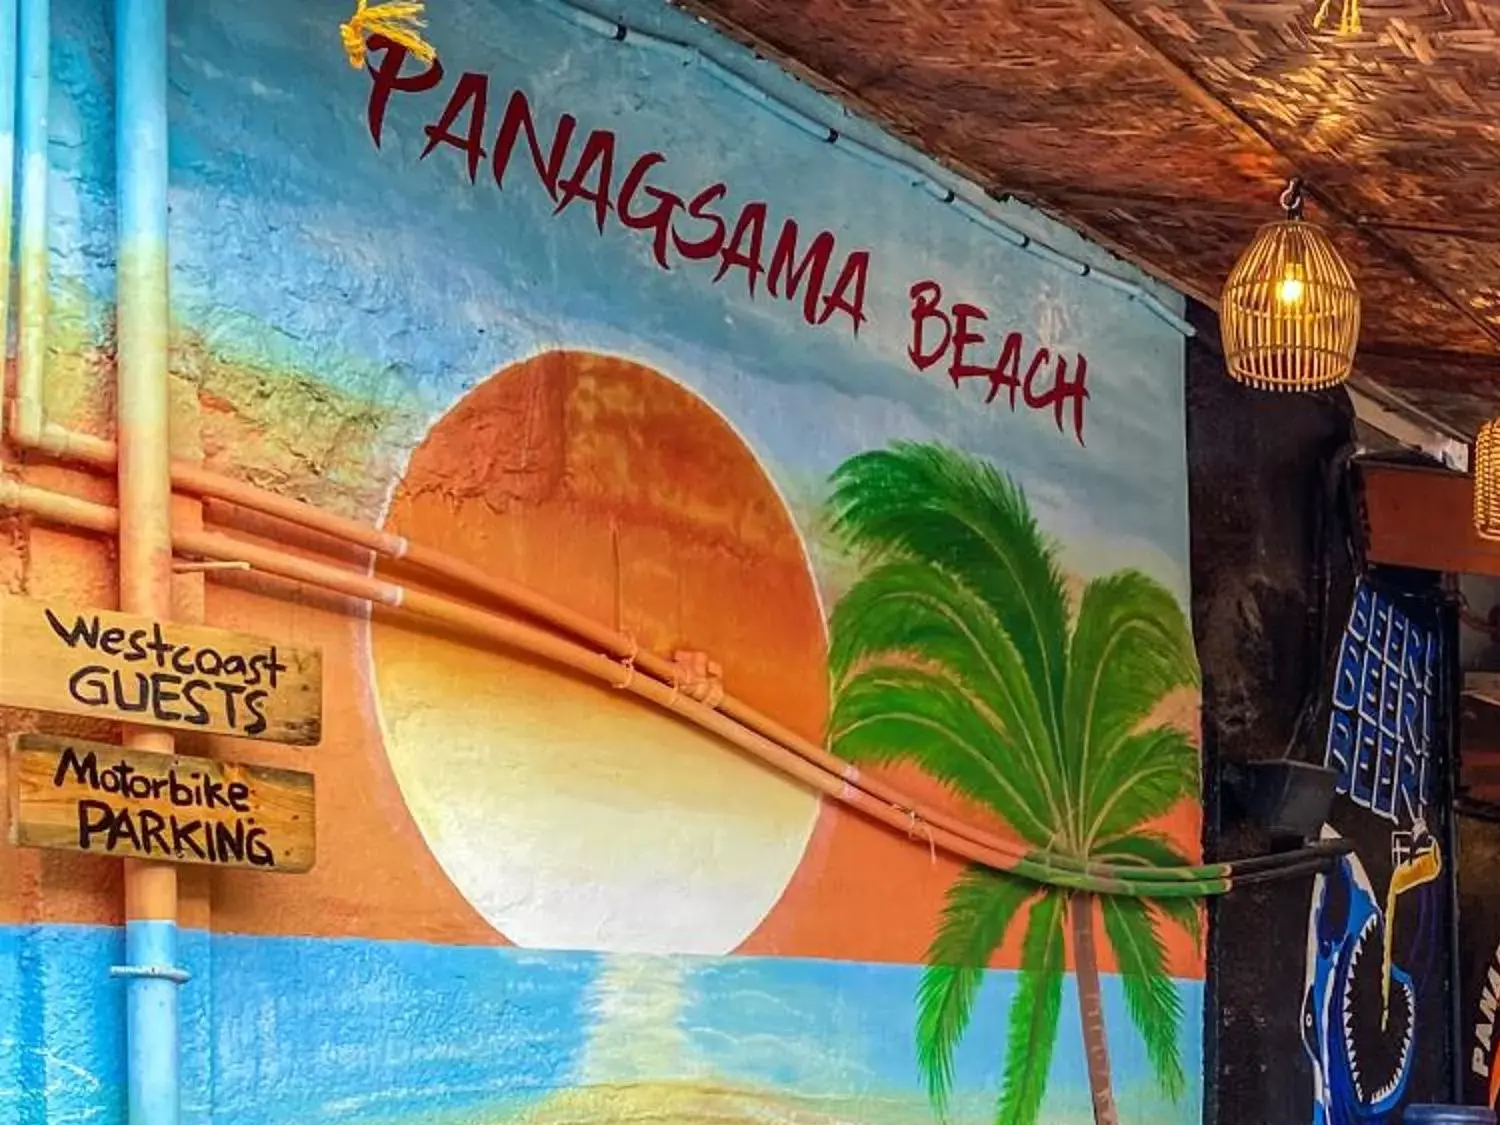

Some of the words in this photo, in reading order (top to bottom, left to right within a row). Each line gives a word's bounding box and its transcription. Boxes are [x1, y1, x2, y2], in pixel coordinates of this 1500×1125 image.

[365, 33, 871, 339] PANAGSAMA
[907, 280, 1090, 448] BEACH
[44, 607, 288, 689] Westcoast
[68, 664, 269, 735] GUESTS
[53, 746, 251, 813] Motorbike
[78, 799, 276, 867] PARKING
